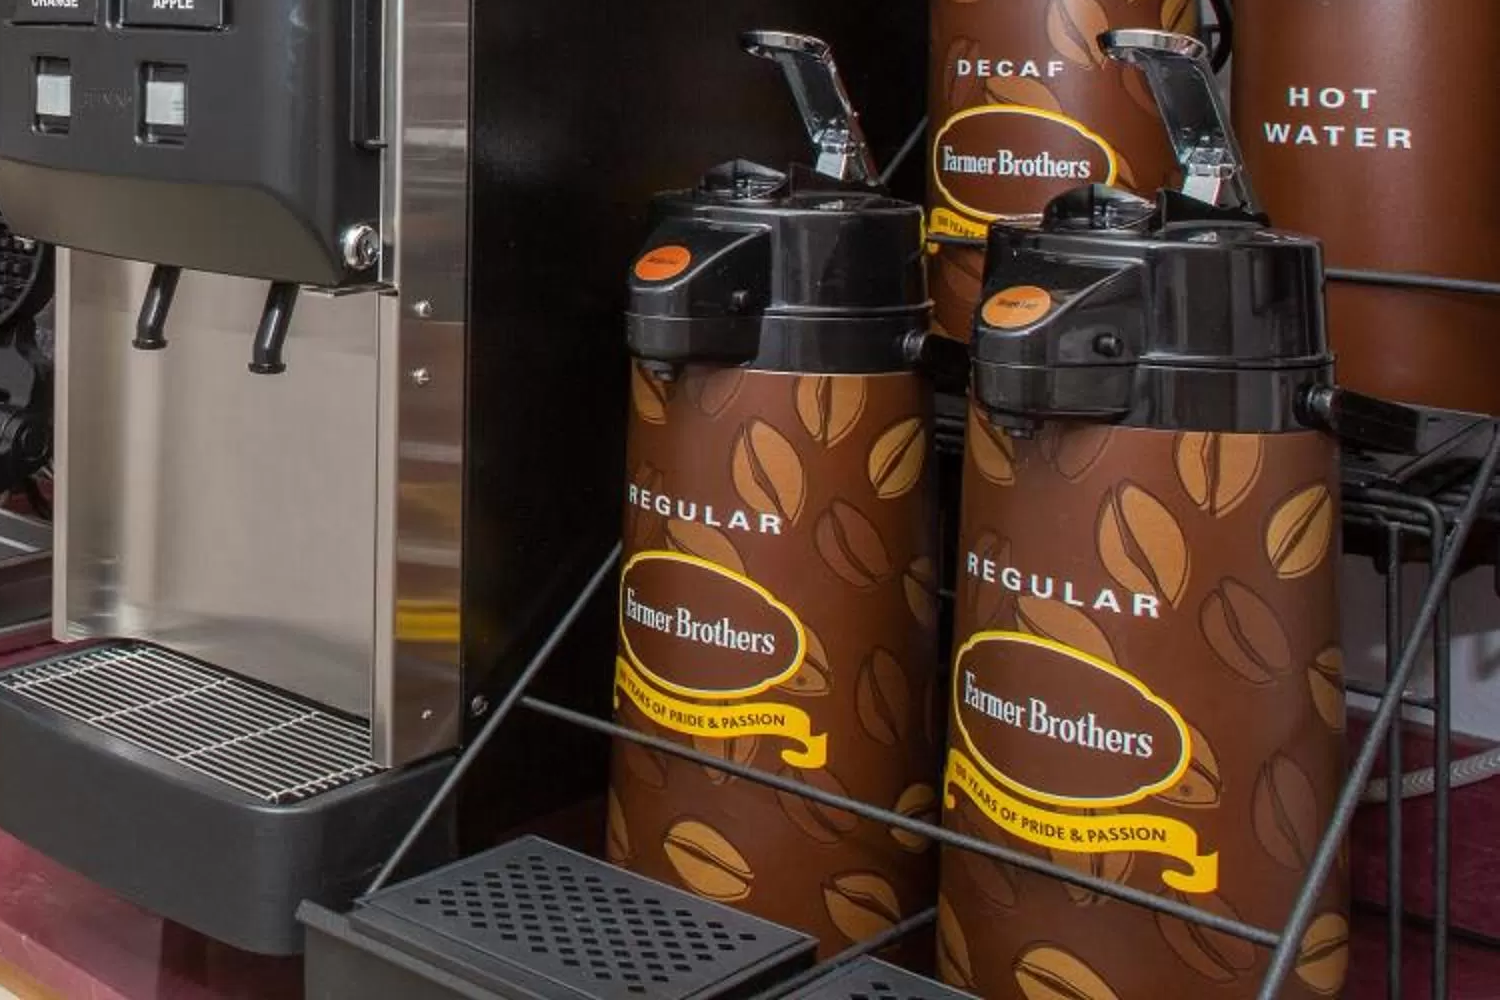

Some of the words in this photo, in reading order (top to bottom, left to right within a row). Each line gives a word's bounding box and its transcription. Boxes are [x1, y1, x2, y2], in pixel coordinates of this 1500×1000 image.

[956, 58, 1065, 78] DECAF
[1288, 86, 1378, 110] HOT
[1263, 121, 1413, 150] WATER
[942, 145, 997, 175] Farmer
[997, 149, 1091, 179] Brothers
[628, 482, 782, 535] REGULAR
[966, 551, 1161, 619] REGULAR
[625, 586, 673, 634] Farmer
[675, 606, 776, 656] Brothers
[652, 701, 667, 718] OF
[669, 708, 706, 729] PRIDE
[707, 716, 720, 730] &
[721, 713, 788, 730] PASSION
[963, 670, 1027, 729] Farmer
[1027, 696, 1154, 759] Brothers
[1000, 806, 1019, 823] OF
[1020, 815, 1066, 842] PRIDE
[1069, 827, 1085, 844] &
[1087, 826, 1168, 844] PASSION
